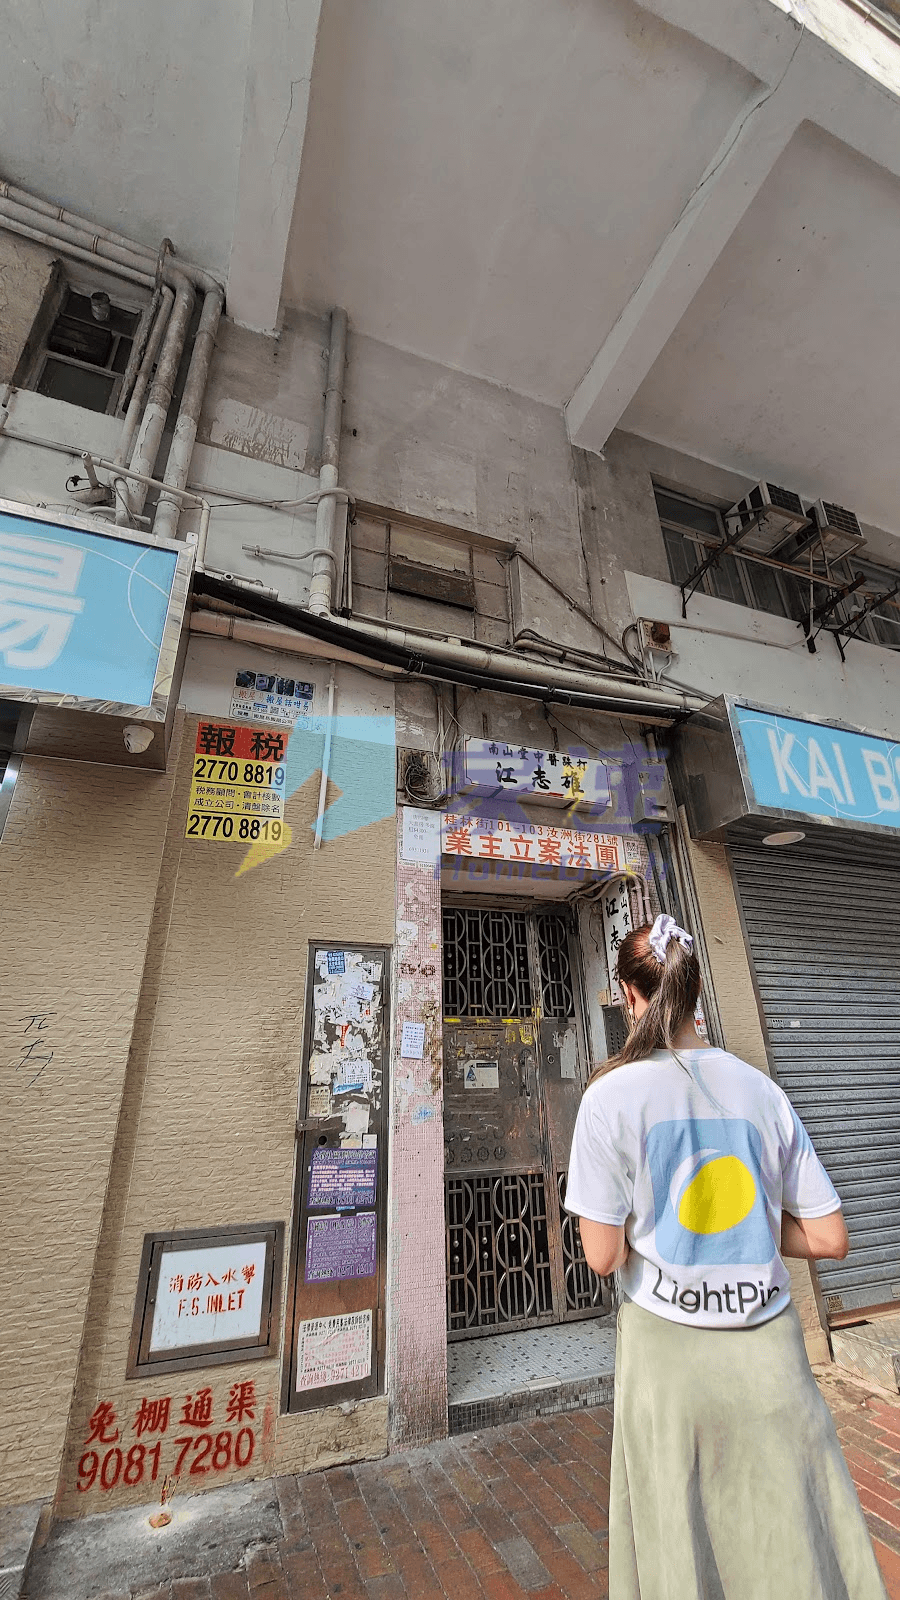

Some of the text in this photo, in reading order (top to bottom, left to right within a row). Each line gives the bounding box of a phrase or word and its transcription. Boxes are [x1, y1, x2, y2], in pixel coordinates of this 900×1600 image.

[194, 758, 285, 786] 2770 8819
[767, 728, 900, 812] KAI B
[187, 814, 282, 842] 2770 8819
[445, 827, 620, 872] 業主立案法團
[84, 1380, 257, 1445] 免棚通渠
[77, 1427, 256, 1493] 9081 7280
